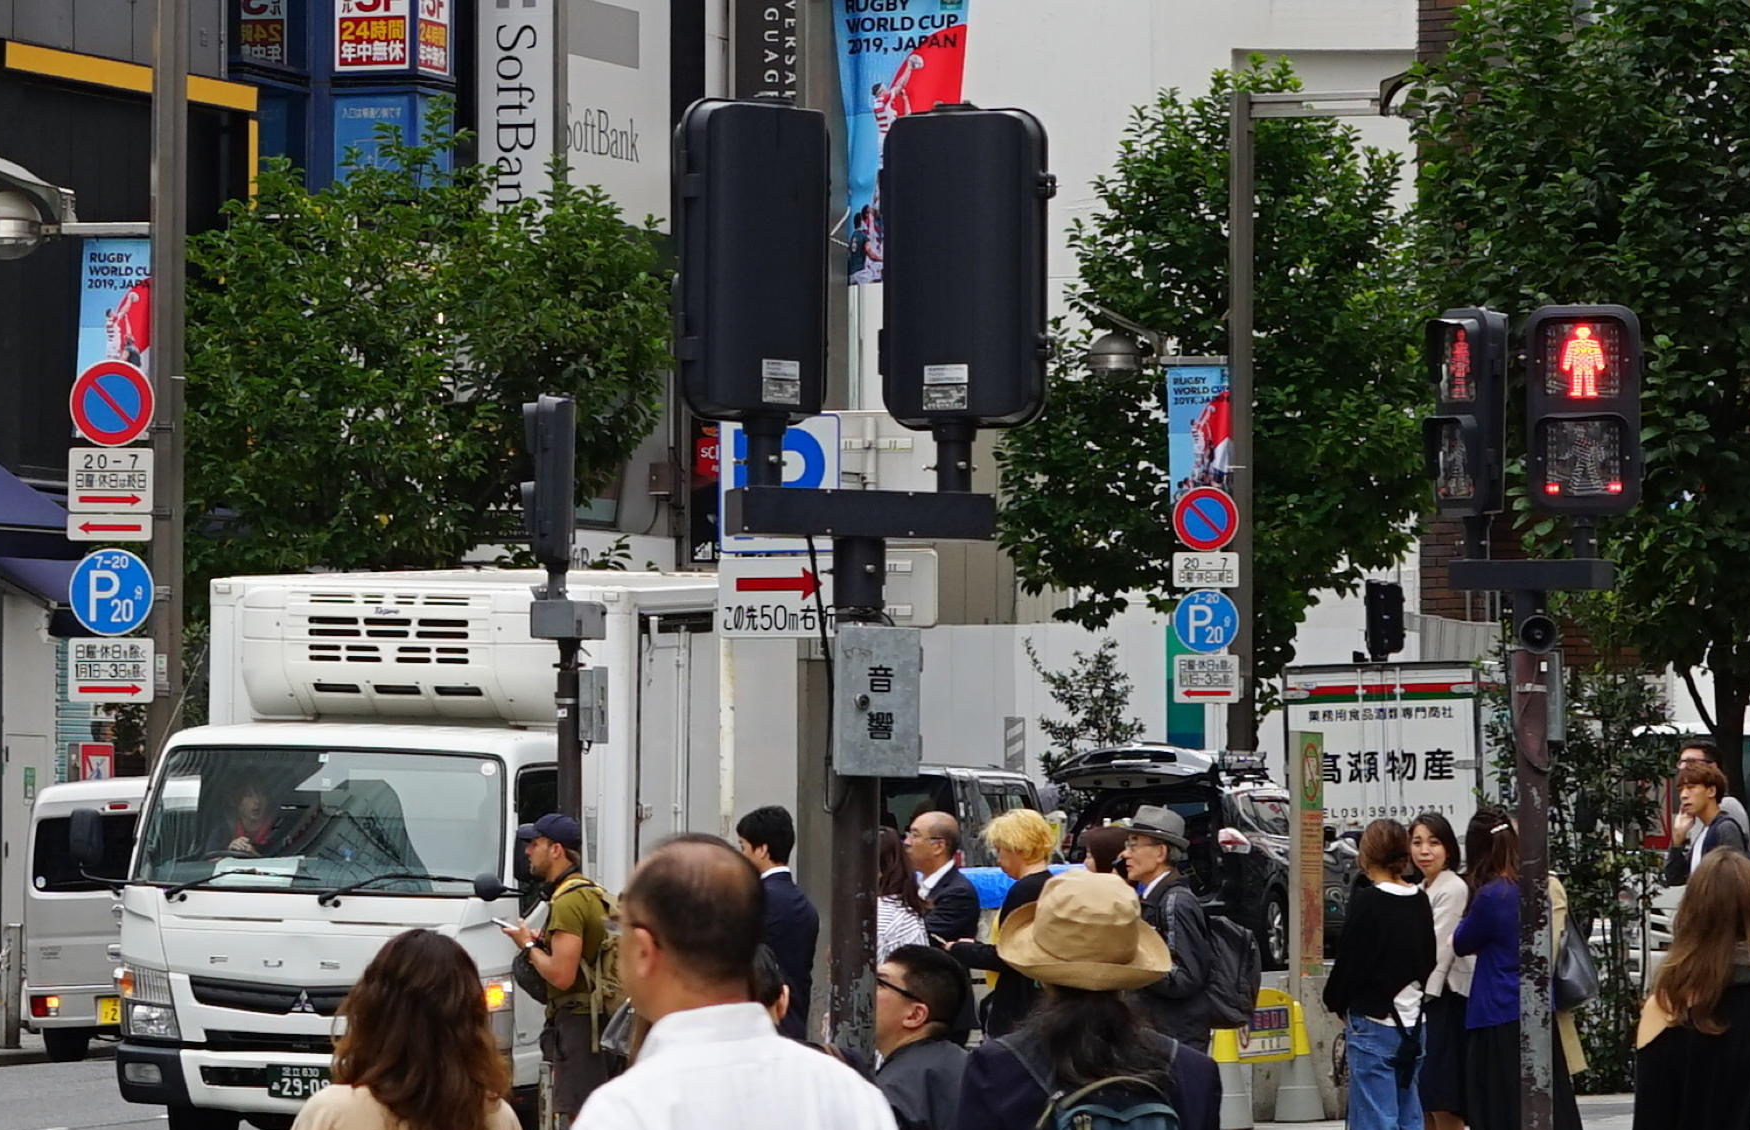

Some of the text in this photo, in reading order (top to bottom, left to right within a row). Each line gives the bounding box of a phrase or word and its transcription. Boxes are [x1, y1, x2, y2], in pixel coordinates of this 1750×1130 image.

[341, 19, 404, 40] 24時間
[845, 14, 959, 34] WORLD CUP
[419, 24, 447, 47] 24時間
[847, 34, 958, 55] 2019, JAPAN
[341, 40, 404, 63] 年中無休
[419, 43, 447, 67] 年中無休
[89, 252, 133, 263] RUGBY
[89, 265, 134, 277] WORLD
[87, 279, 117, 291] 2019,
[1172, 376, 1207, 385] RUGBY
[1173, 386, 1211, 395] WORLD
[94, 555, 129, 569] 7-20
[89, 569, 120, 622] P
[110, 598, 134, 623] 20
[1188, 604, 1213, 644] P
[1205, 625, 1224, 644] 20
[867, 663, 895, 740] 音響
